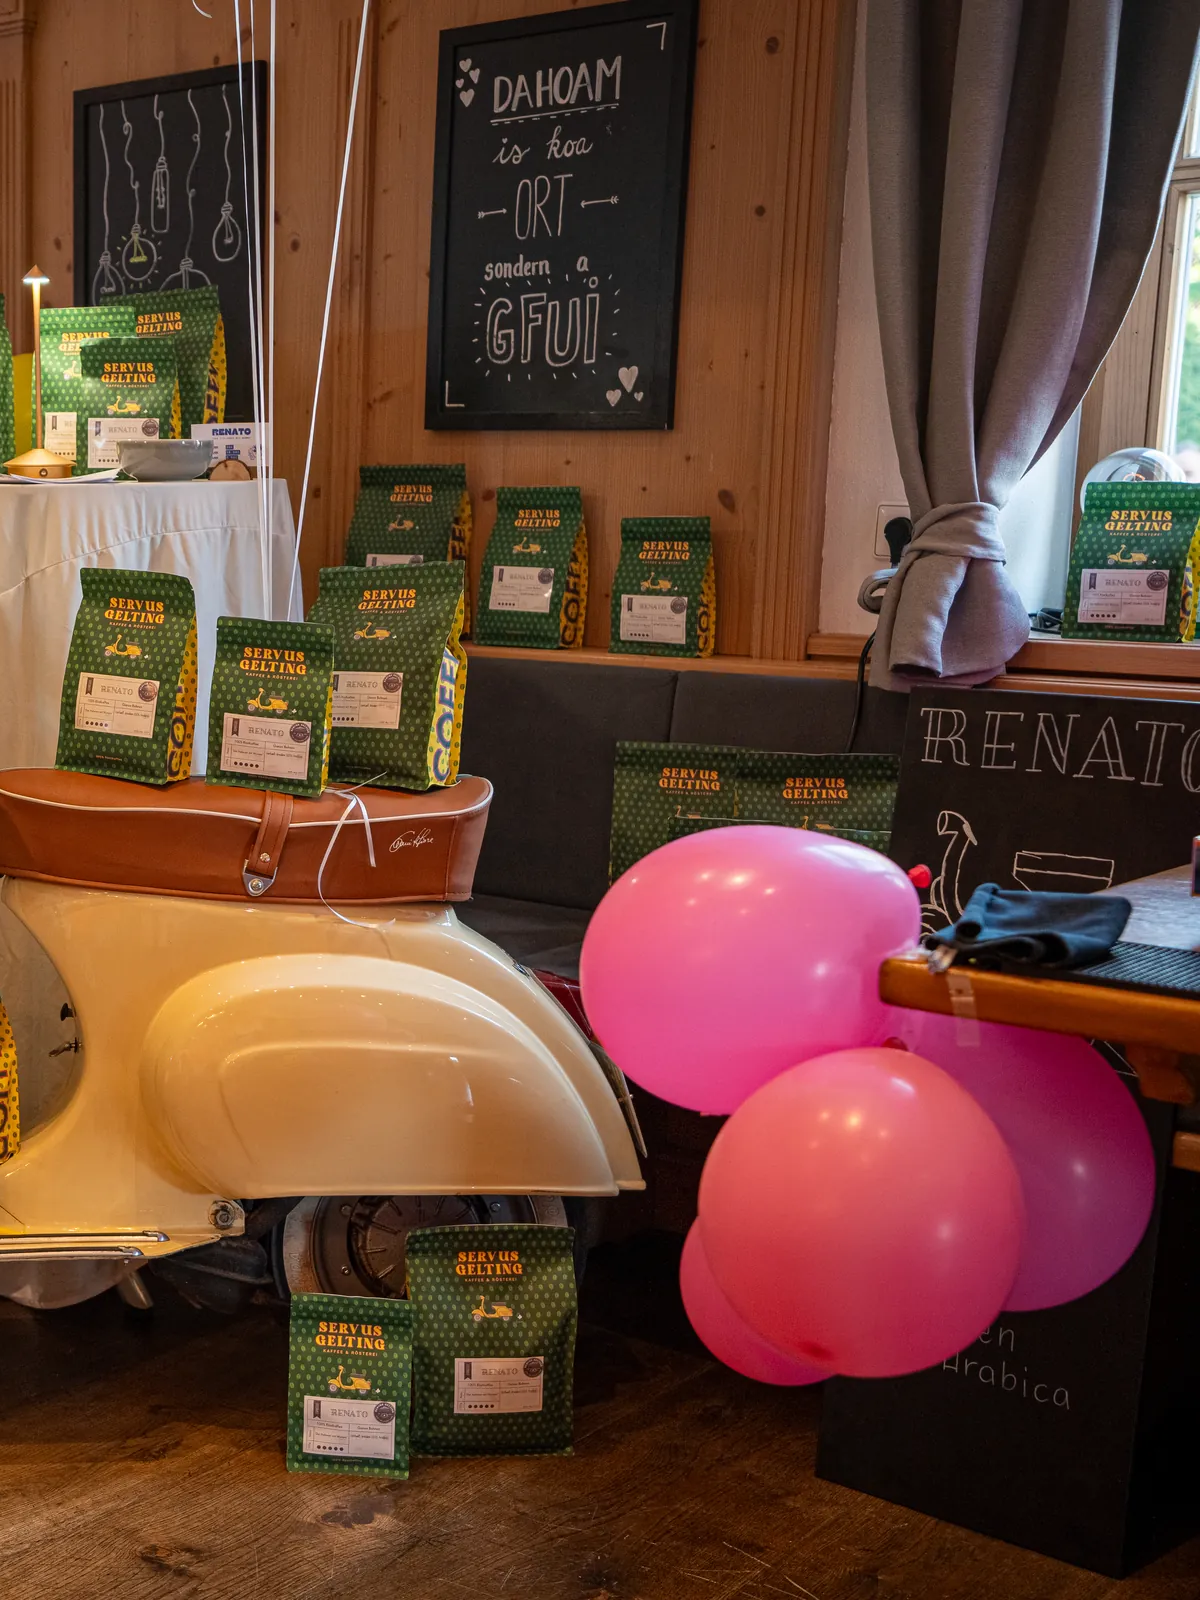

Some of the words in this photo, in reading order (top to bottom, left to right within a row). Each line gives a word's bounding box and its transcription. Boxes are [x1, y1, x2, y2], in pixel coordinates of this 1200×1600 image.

[493, 55, 622, 113] DAHOAM
[492, 138, 531, 165] is
[547, 125, 594, 160] koa
[514, 173, 573, 240] ORT
[484, 253, 551, 281] sondern
[576, 255, 589, 272] a
[137, 312, 181, 324] SERVUS
[135, 321, 182, 333] GELTING
[104, 362, 154, 372] SERVUS
[101, 373, 156, 383] GELTING
[211, 428, 251, 436] RENATO
[394, 485, 432, 493] SERVUS
[390, 494, 433, 503] GELTING
[518, 509, 560, 518] SERVUS
[1111, 510, 1172, 521] SERVUS
[514, 519, 560, 527] GELTING
[1105, 521, 1172, 531] GELTING
[643, 541, 689, 550] SERVUS
[639, 551, 690, 560] GELTING
[1104, 579, 1141, 587] RENATO
[363, 589, 416, 600] SERVUS
[110, 597, 164, 612] SERVUS
[358, 599, 416, 610] GELTING
[104, 610, 165, 624] GELTING
[243, 647, 305, 662] SERVUS
[239, 660, 307, 675] GELTING
[100, 685, 133, 696] RENATO
[346, 681, 378, 689] RENATO
[248, 726, 284, 737] RENATO
[662, 767, 719, 780] SERVUS
[659, 778, 720, 791] GELTING
[785, 777, 845, 788] SERVUS
[782, 788, 849, 799] GELTING
[458, 1250, 519, 1262] SERVUS
[455, 1263, 523, 1275] GELTING
[319, 1321, 382, 1337] SERVUS
[315, 1334, 385, 1350] GELTING
[481, 1368, 519, 1376] RENATO
[330, 1408, 369, 1418] RENATO
